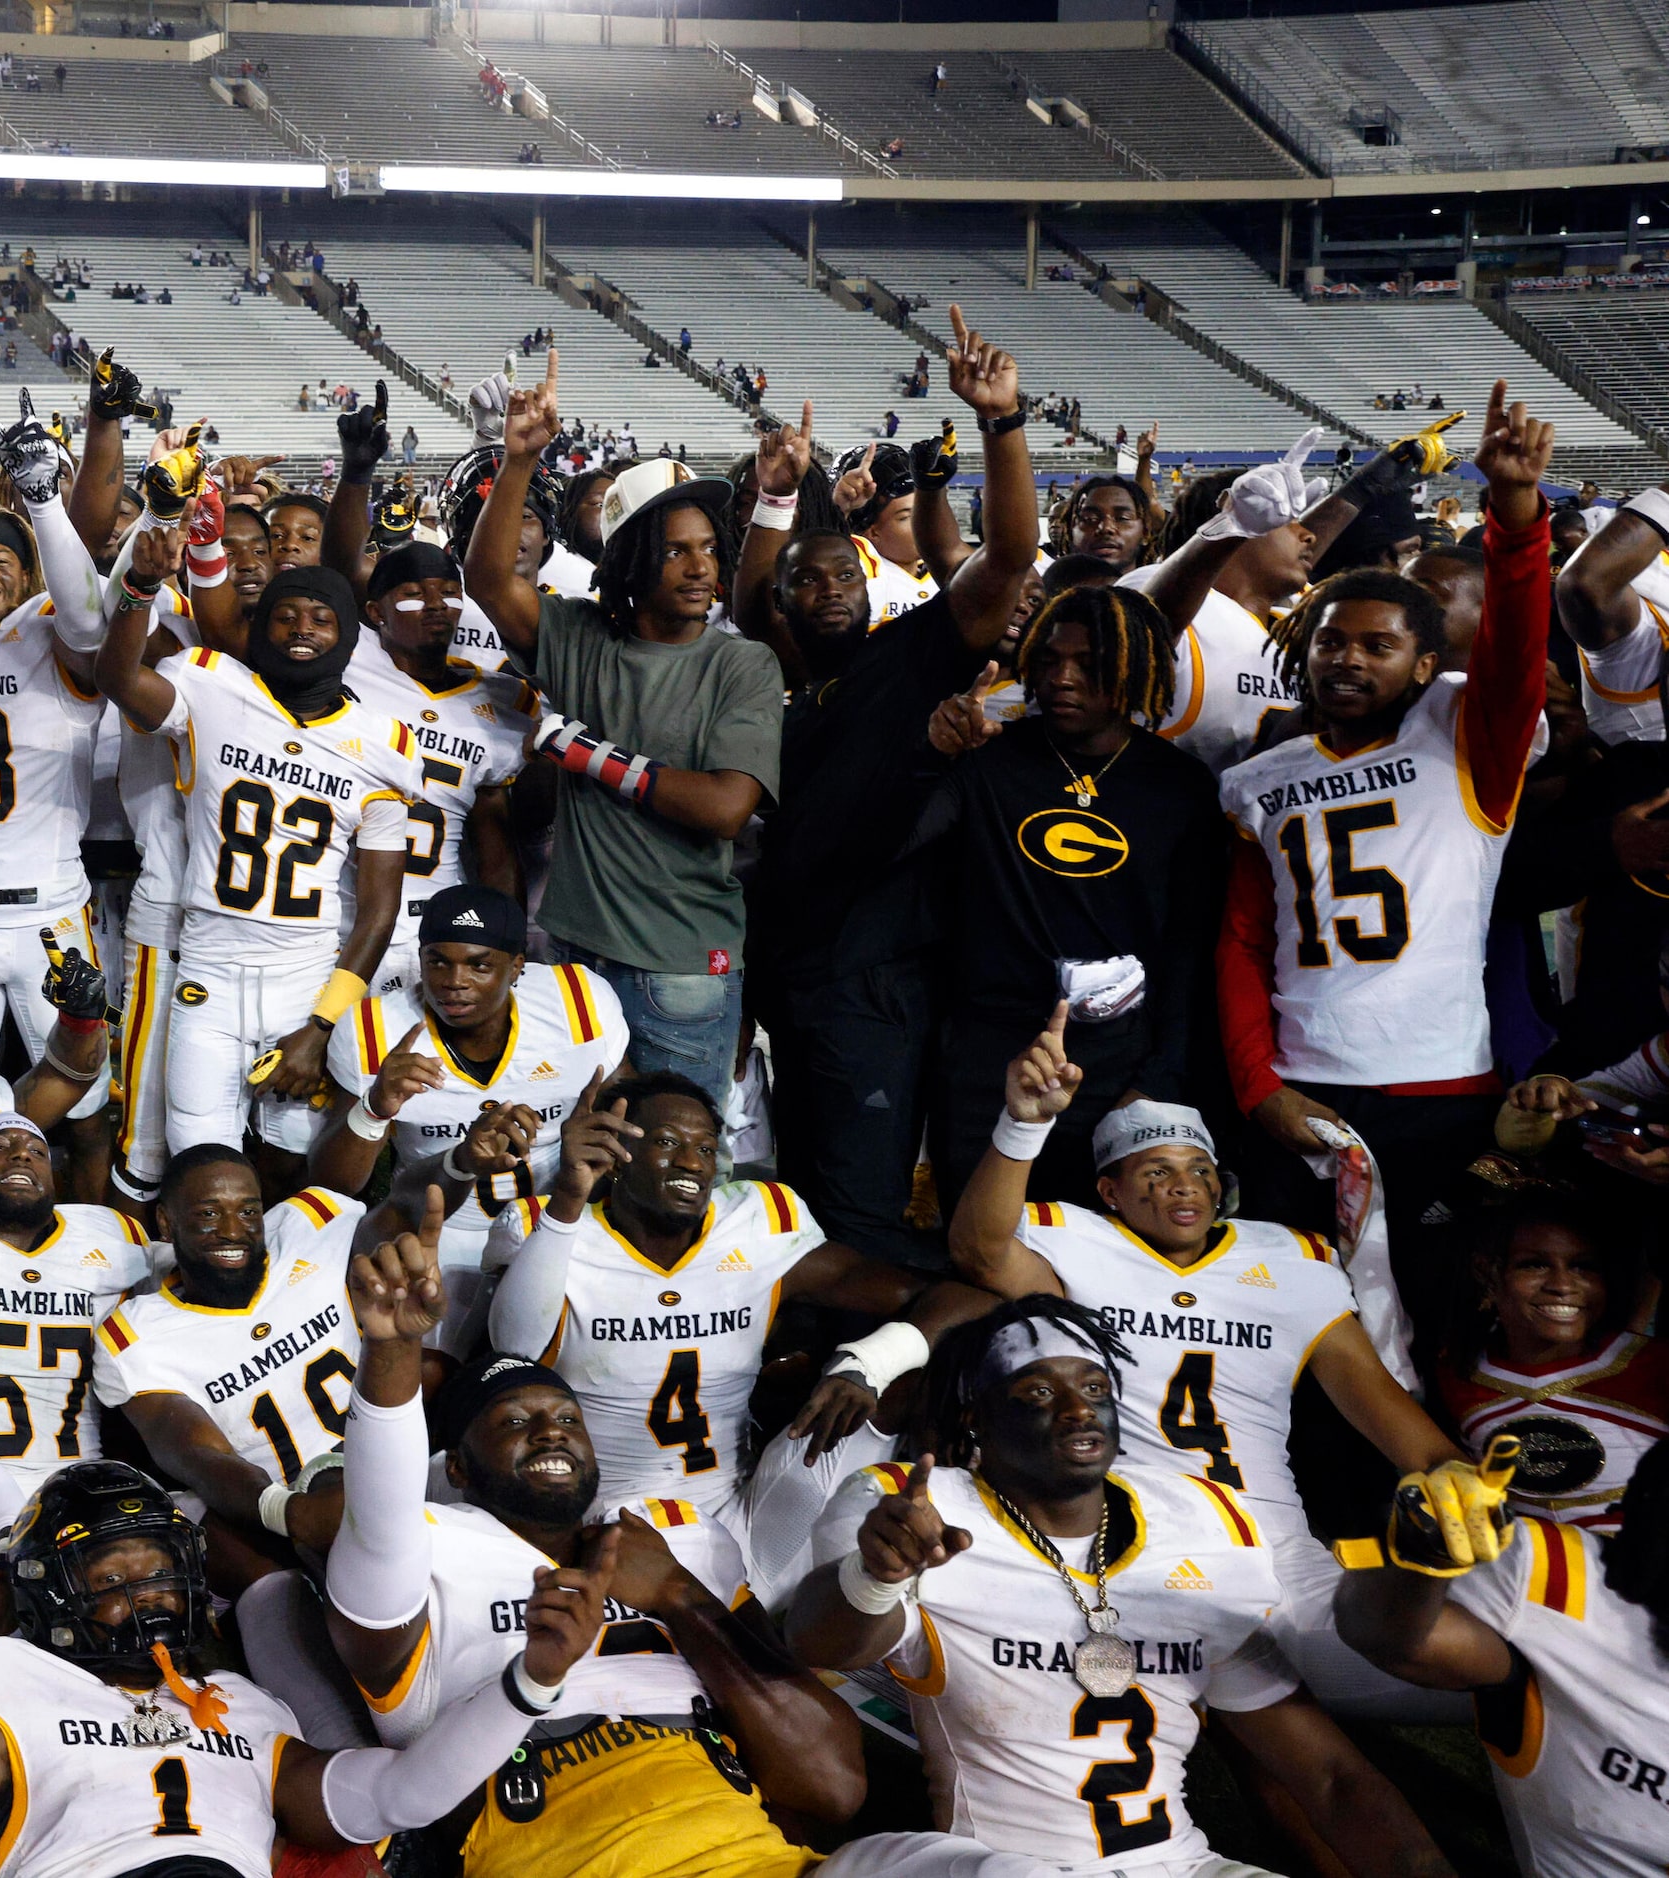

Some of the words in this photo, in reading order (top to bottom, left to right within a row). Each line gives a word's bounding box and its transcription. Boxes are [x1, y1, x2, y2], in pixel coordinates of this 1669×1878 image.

[455, 627, 507, 651] GRA
[1237, 672, 1301, 701] GRAM
[406, 723, 486, 765] MBLING
[220, 743, 353, 800] GRAMBLING
[1257, 757, 1418, 817] GRAMBLING
[213, 776, 337, 920] 82
[1277, 797, 1413, 970] 15
[452, 916, 485, 929] adidas
[421, 1103, 564, 1139] GRANG
[1235, 1275, 1278, 1290] adidas
[591, 1306, 752, 1343] GRAMBLING
[1098, 1305, 1273, 1350] GRAMBLING
[204, 1303, 341, 1405] GRAMBLING
[644, 1347, 720, 1477] 4
[1158, 1349, 1248, 1493] 4
[1163, 1577, 1214, 1591] adidas
[992, 1637, 1204, 1675] GRALING
[150, 1756, 202, 1836] 1
[1069, 1683, 1174, 1859] 2
[1600, 1747, 1669, 1806] GR
